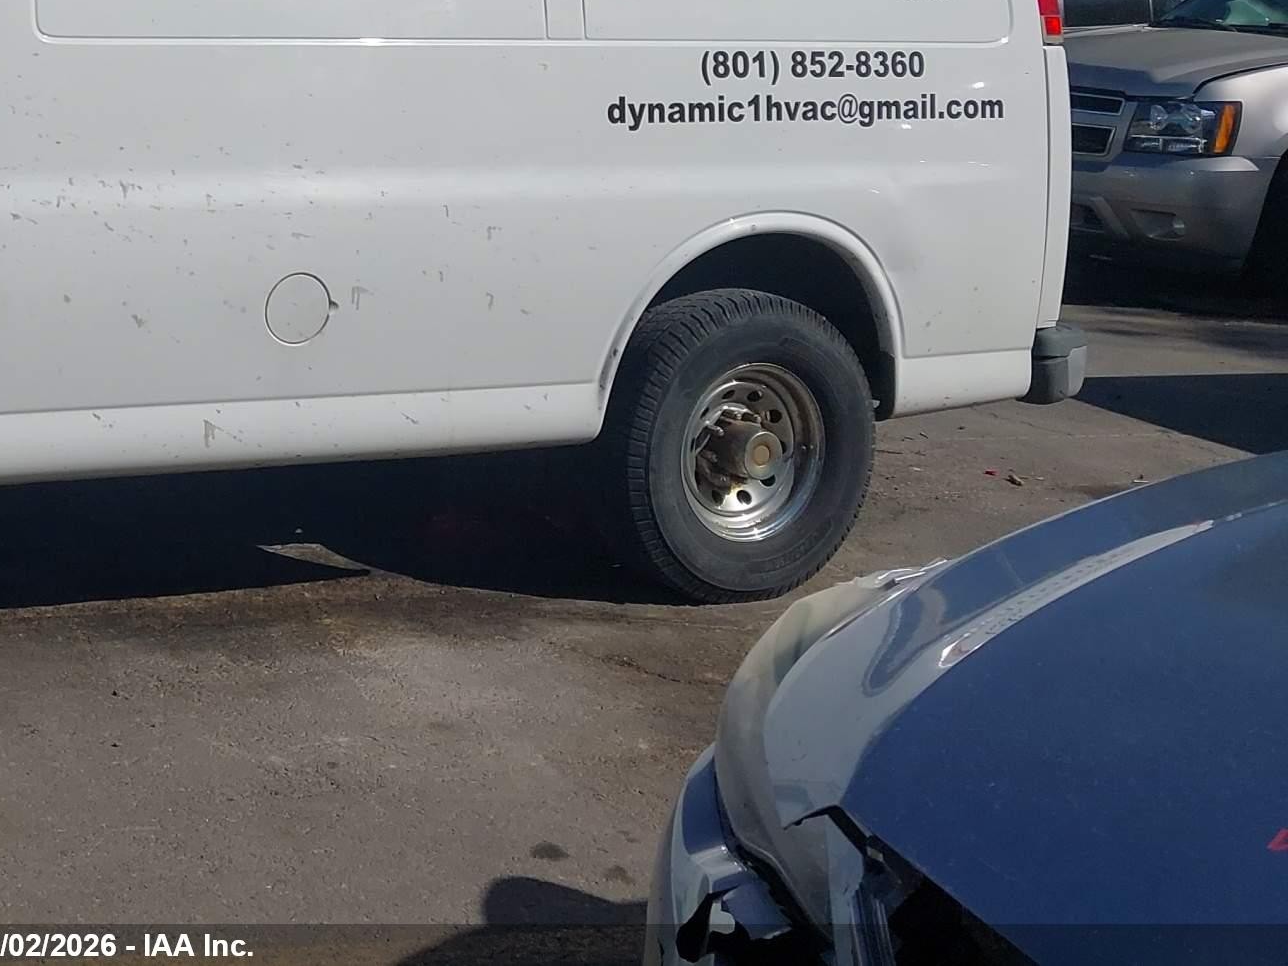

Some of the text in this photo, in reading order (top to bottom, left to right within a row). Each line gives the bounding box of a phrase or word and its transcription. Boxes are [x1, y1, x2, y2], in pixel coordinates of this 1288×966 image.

[701, 50, 925, 86] (801) 852-8360
[607, 94, 1004, 132] dynamic1hvac@gmail.com
